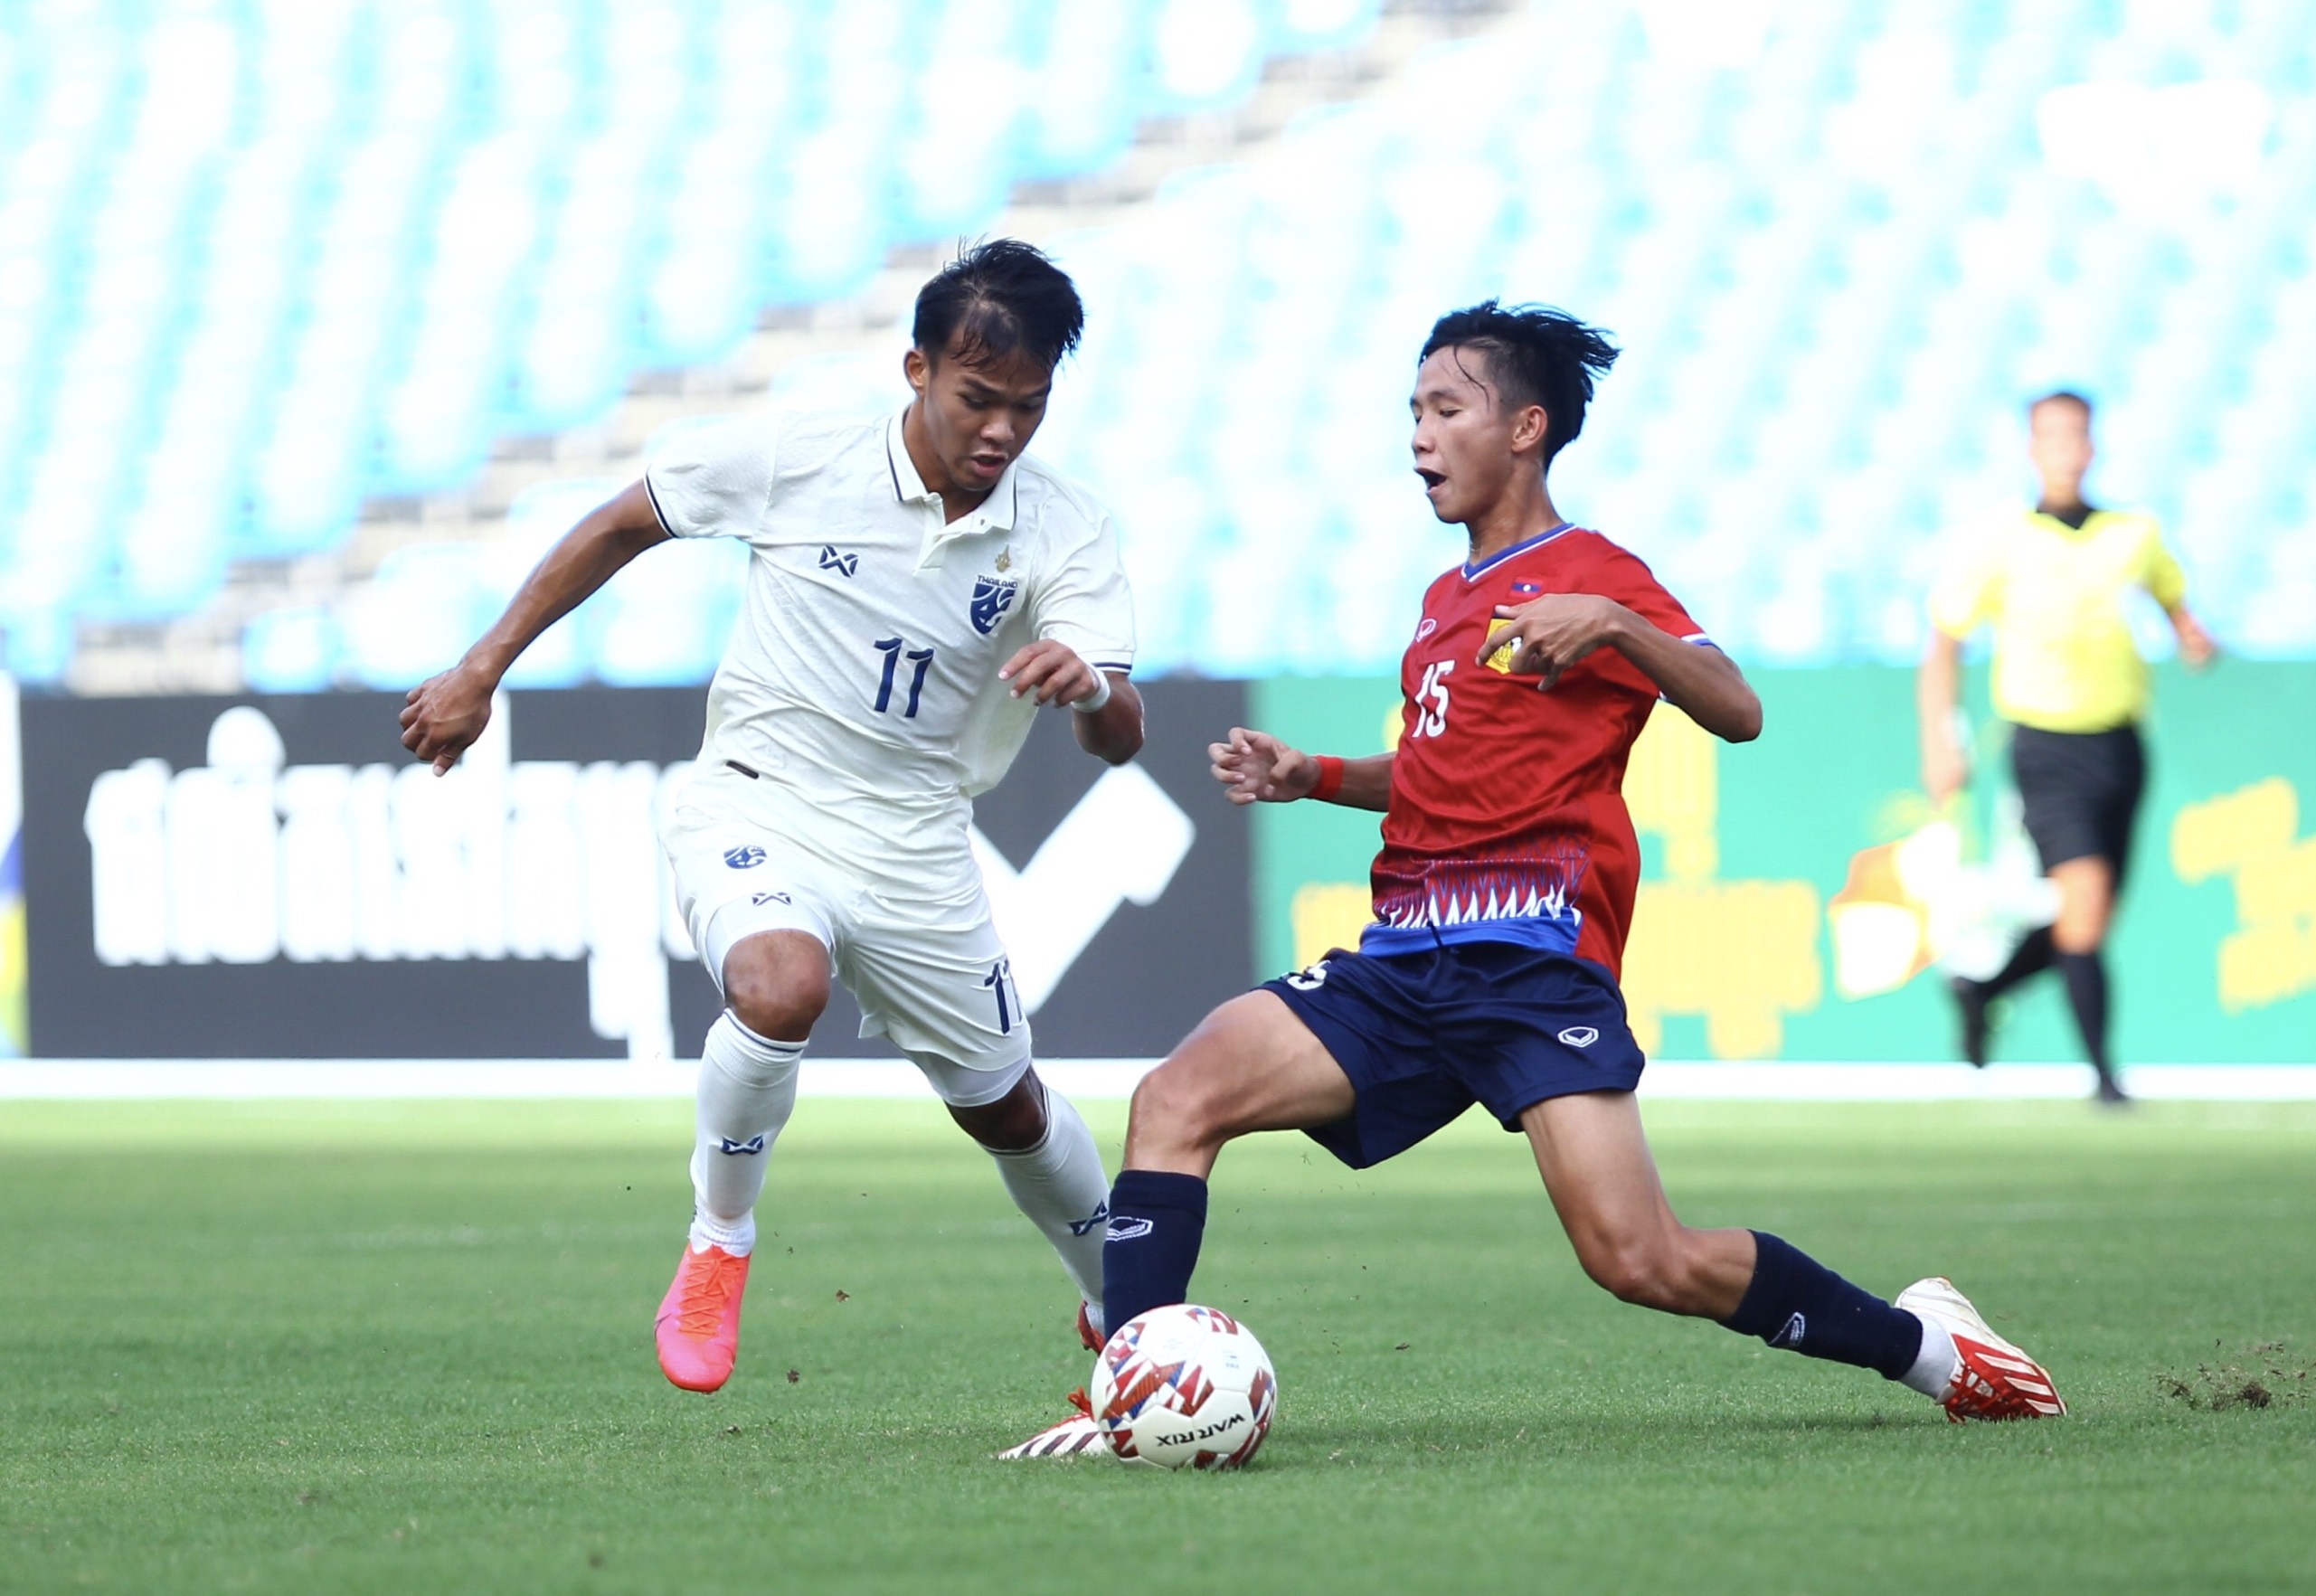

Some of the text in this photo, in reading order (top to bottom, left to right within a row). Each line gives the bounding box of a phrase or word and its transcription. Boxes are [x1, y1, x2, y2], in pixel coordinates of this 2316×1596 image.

[977, 574, 1018, 589] THAILAND
[874, 637, 935, 718] 11
[1412, 659, 1456, 738] 15
[1280, 959, 1331, 990] 5
[1155, 1412, 1246, 1447] WARRIX
